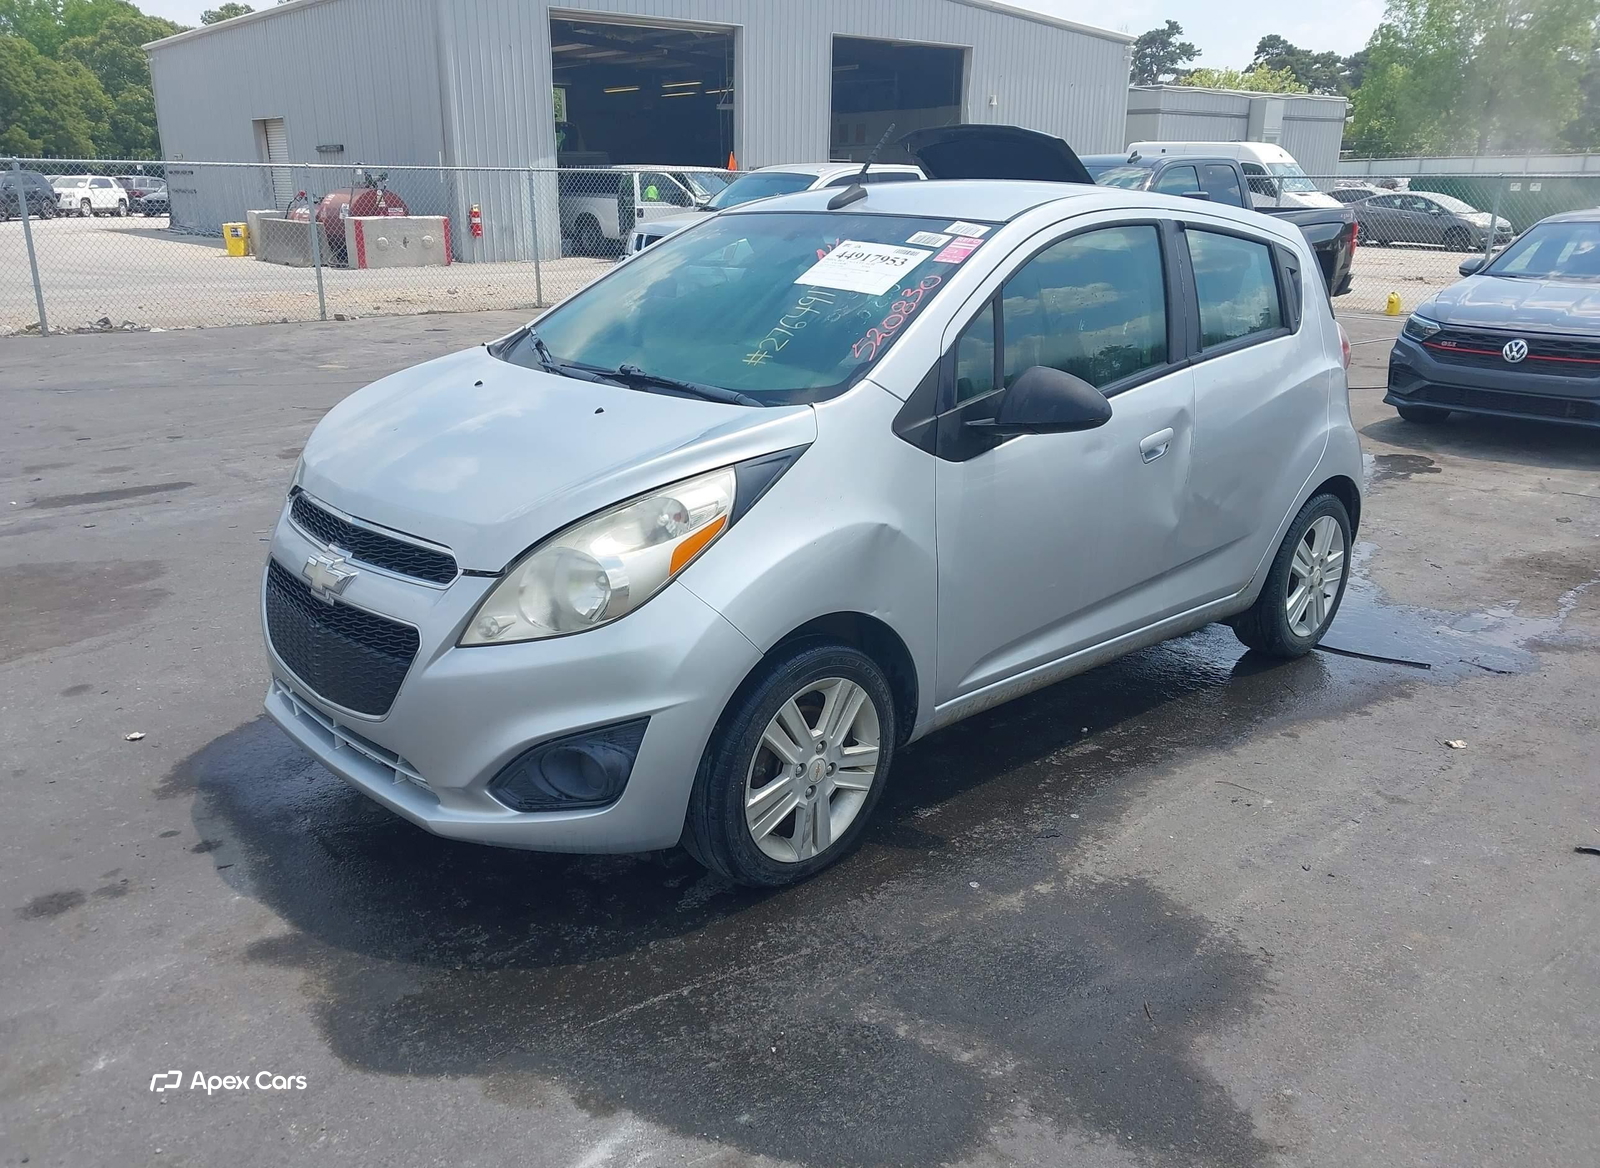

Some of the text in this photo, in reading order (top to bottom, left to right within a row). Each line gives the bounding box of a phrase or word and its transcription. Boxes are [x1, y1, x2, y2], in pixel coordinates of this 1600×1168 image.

[836, 250, 908, 267] 44917953
[742, 285, 836, 366] #276491
[852, 275, 942, 361] 520830
[1503, 339, 1528, 363] VW
